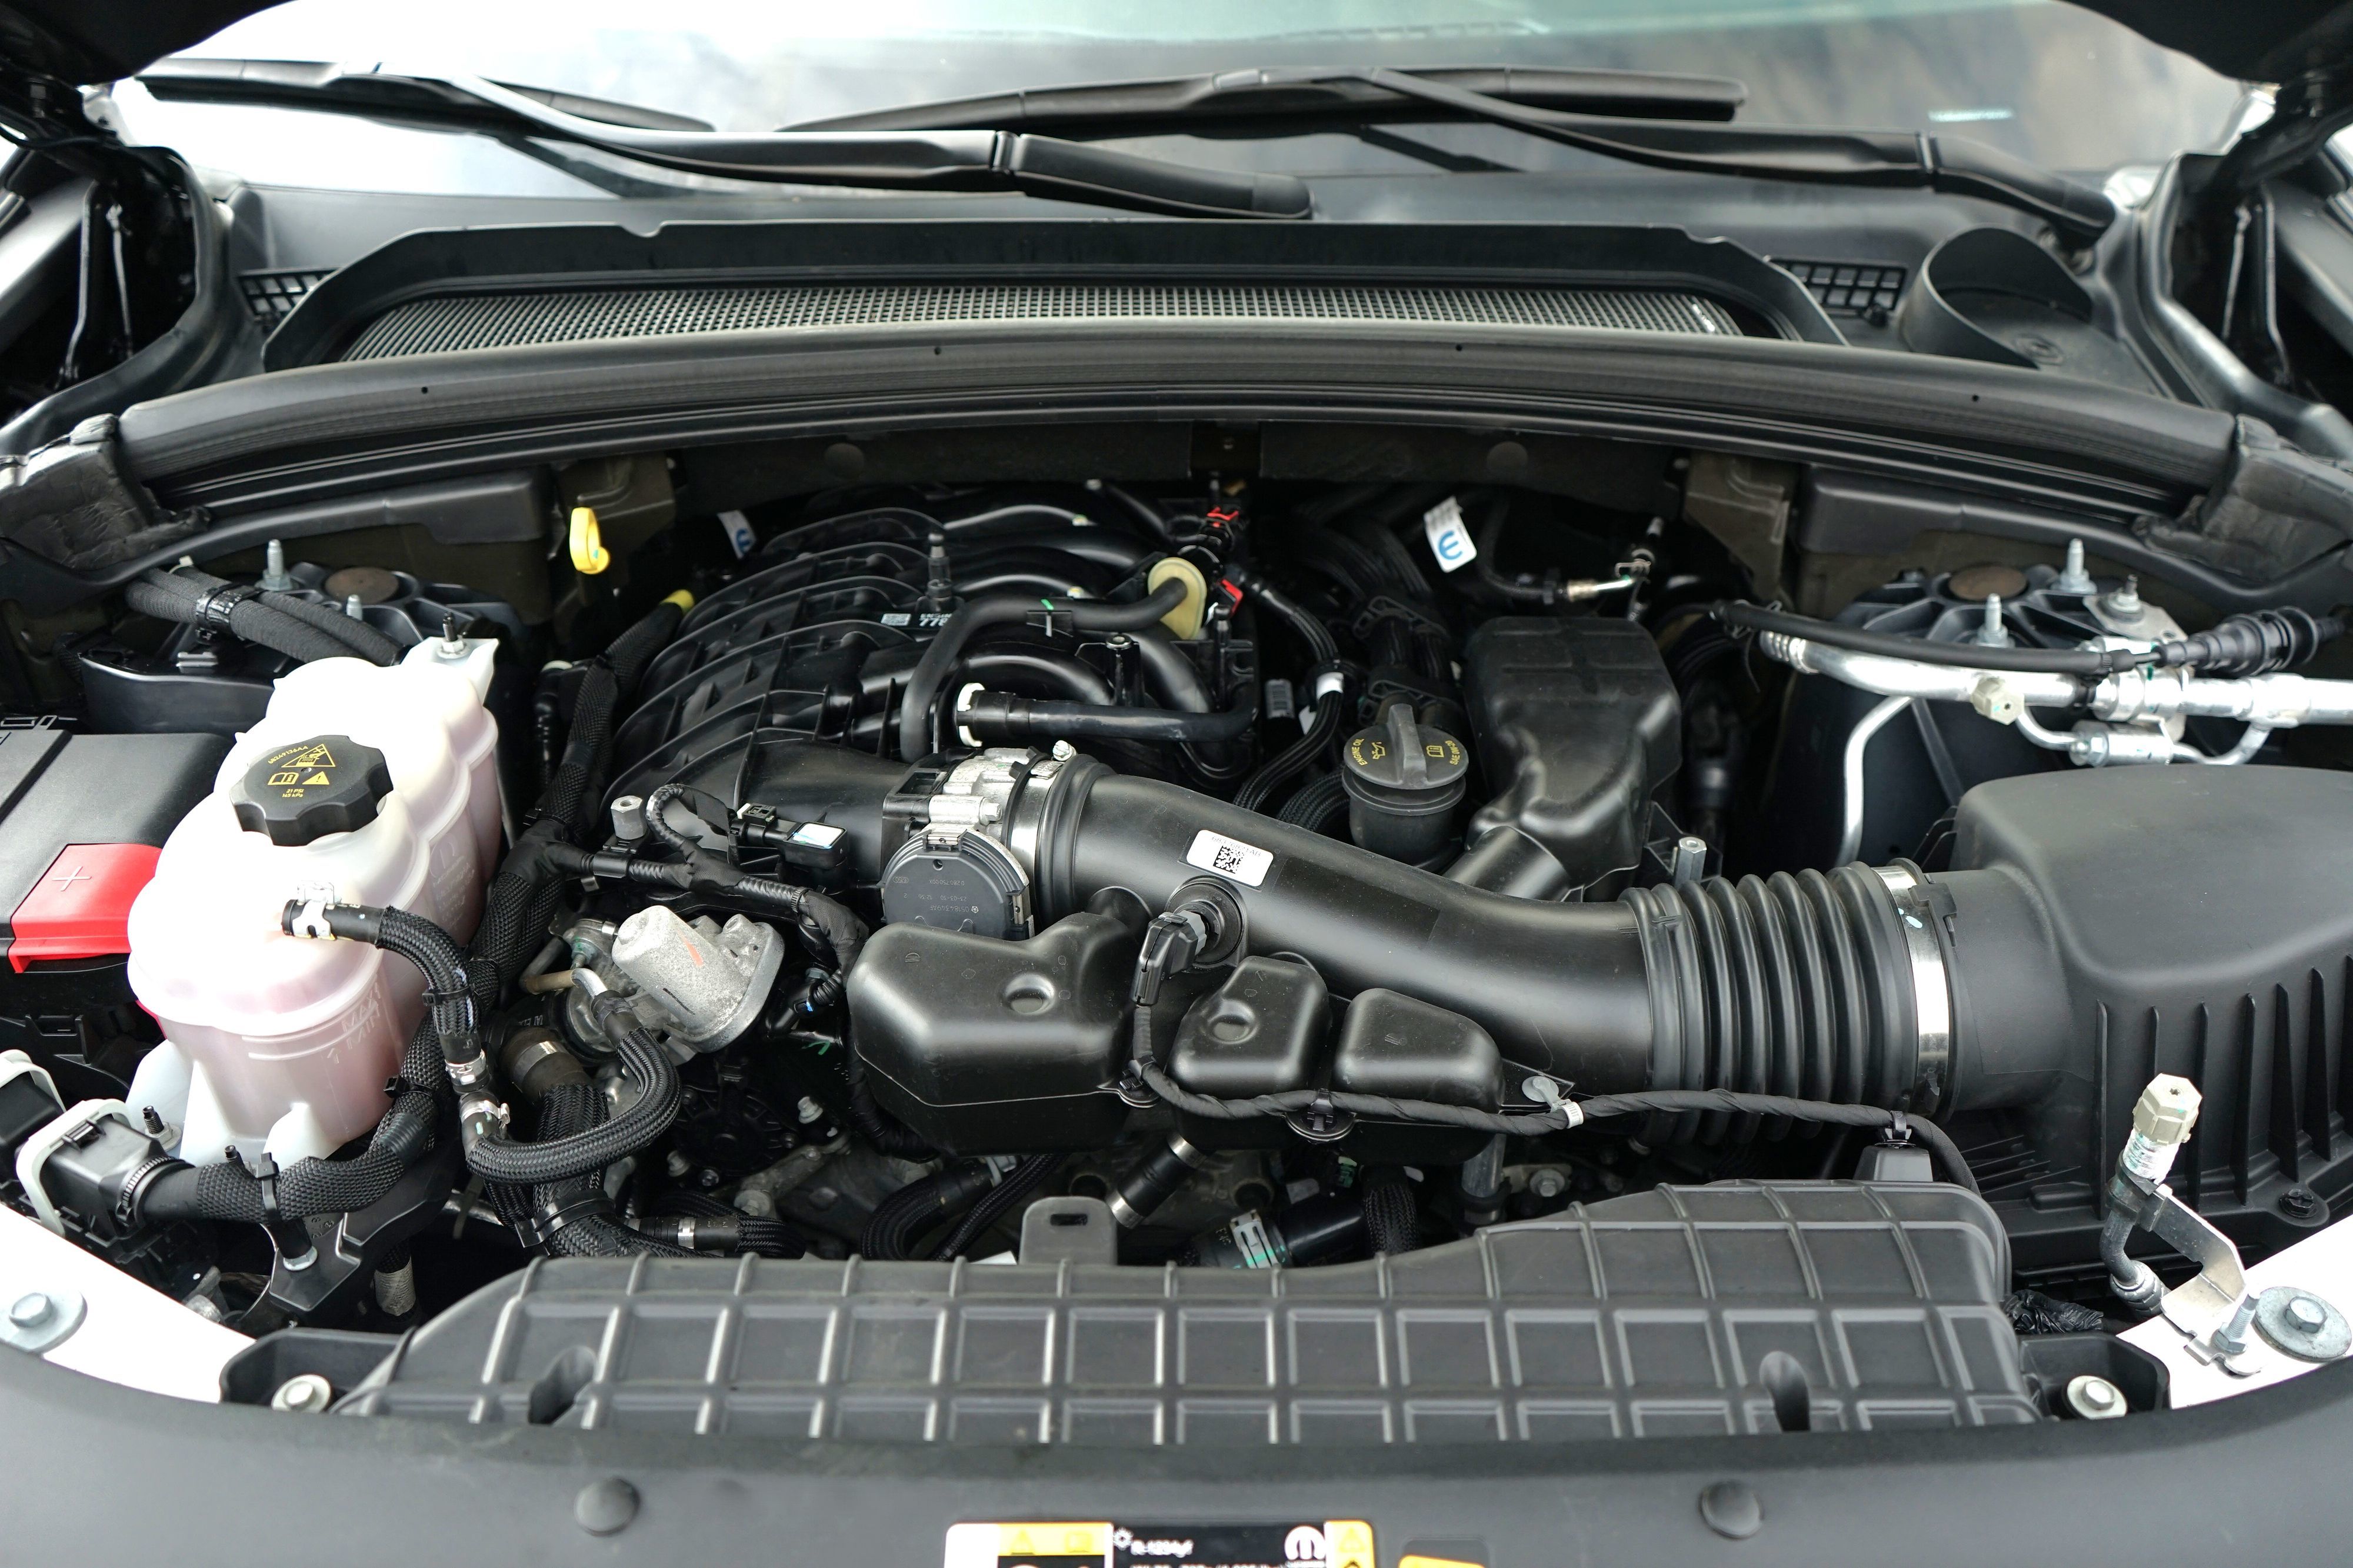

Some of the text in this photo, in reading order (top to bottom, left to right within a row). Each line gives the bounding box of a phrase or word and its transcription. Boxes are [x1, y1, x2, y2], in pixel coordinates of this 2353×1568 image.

[1351, 738, 1368, 766] ENGINE OIL
[1449, 754, 1461, 765] SAE
